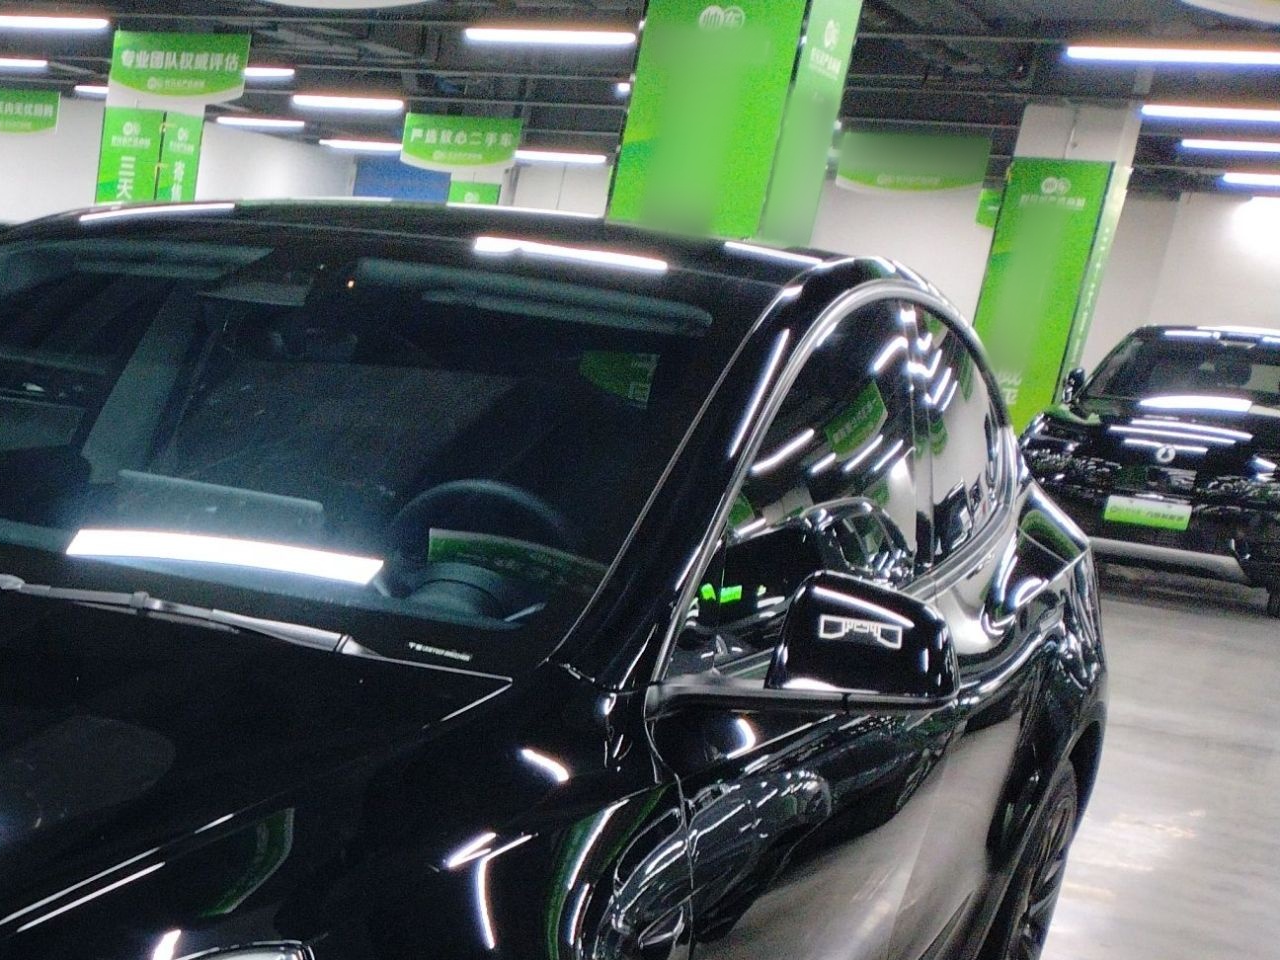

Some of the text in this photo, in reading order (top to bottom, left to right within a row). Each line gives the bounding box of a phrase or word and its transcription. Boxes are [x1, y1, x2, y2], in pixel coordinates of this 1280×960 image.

[121, 50, 239, 71] 专业团队权威评估
